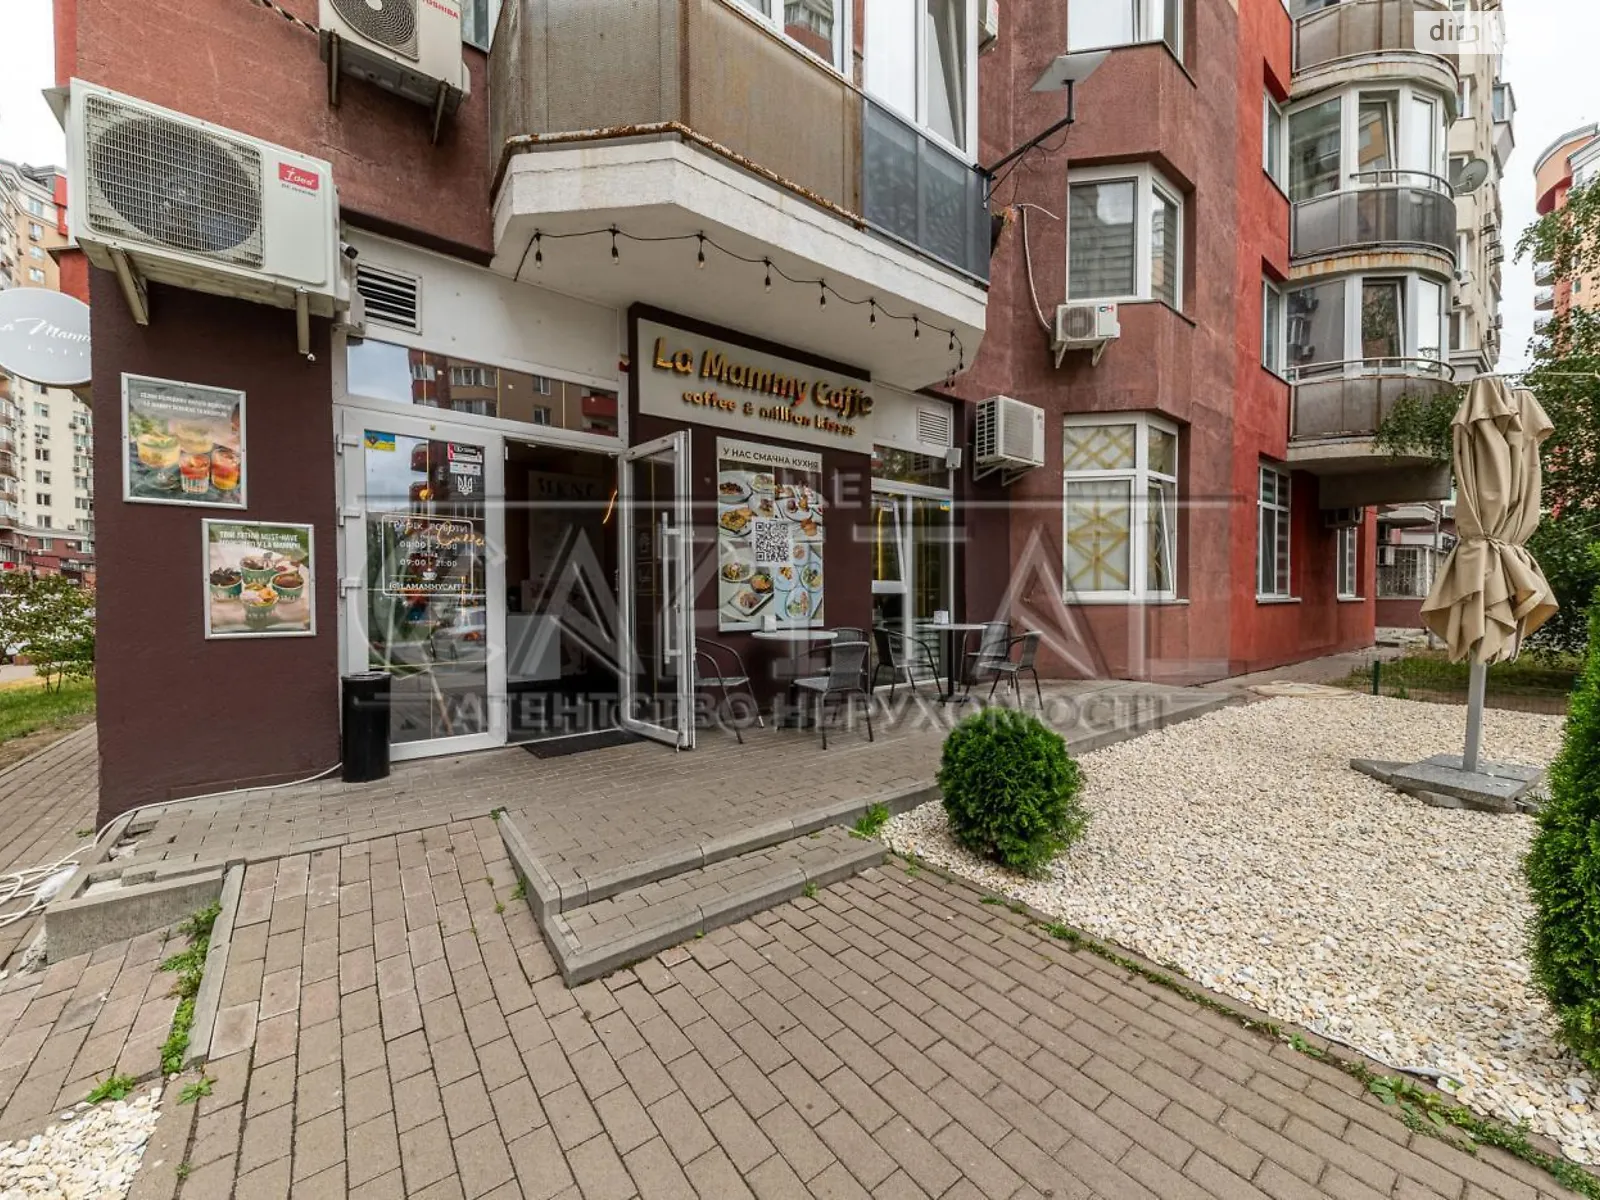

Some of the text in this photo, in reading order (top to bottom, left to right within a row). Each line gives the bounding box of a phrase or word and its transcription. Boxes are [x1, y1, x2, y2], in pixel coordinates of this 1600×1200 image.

[653, 335, 693, 374] La
[700, 349, 808, 405] Mammy
[682, 388, 857, 437] coffee & million kisses
[731, 448, 752, 459] НАС
[752, 451, 791, 465] СМАЧНА
[792, 457, 819, 469] КУХНЯ
